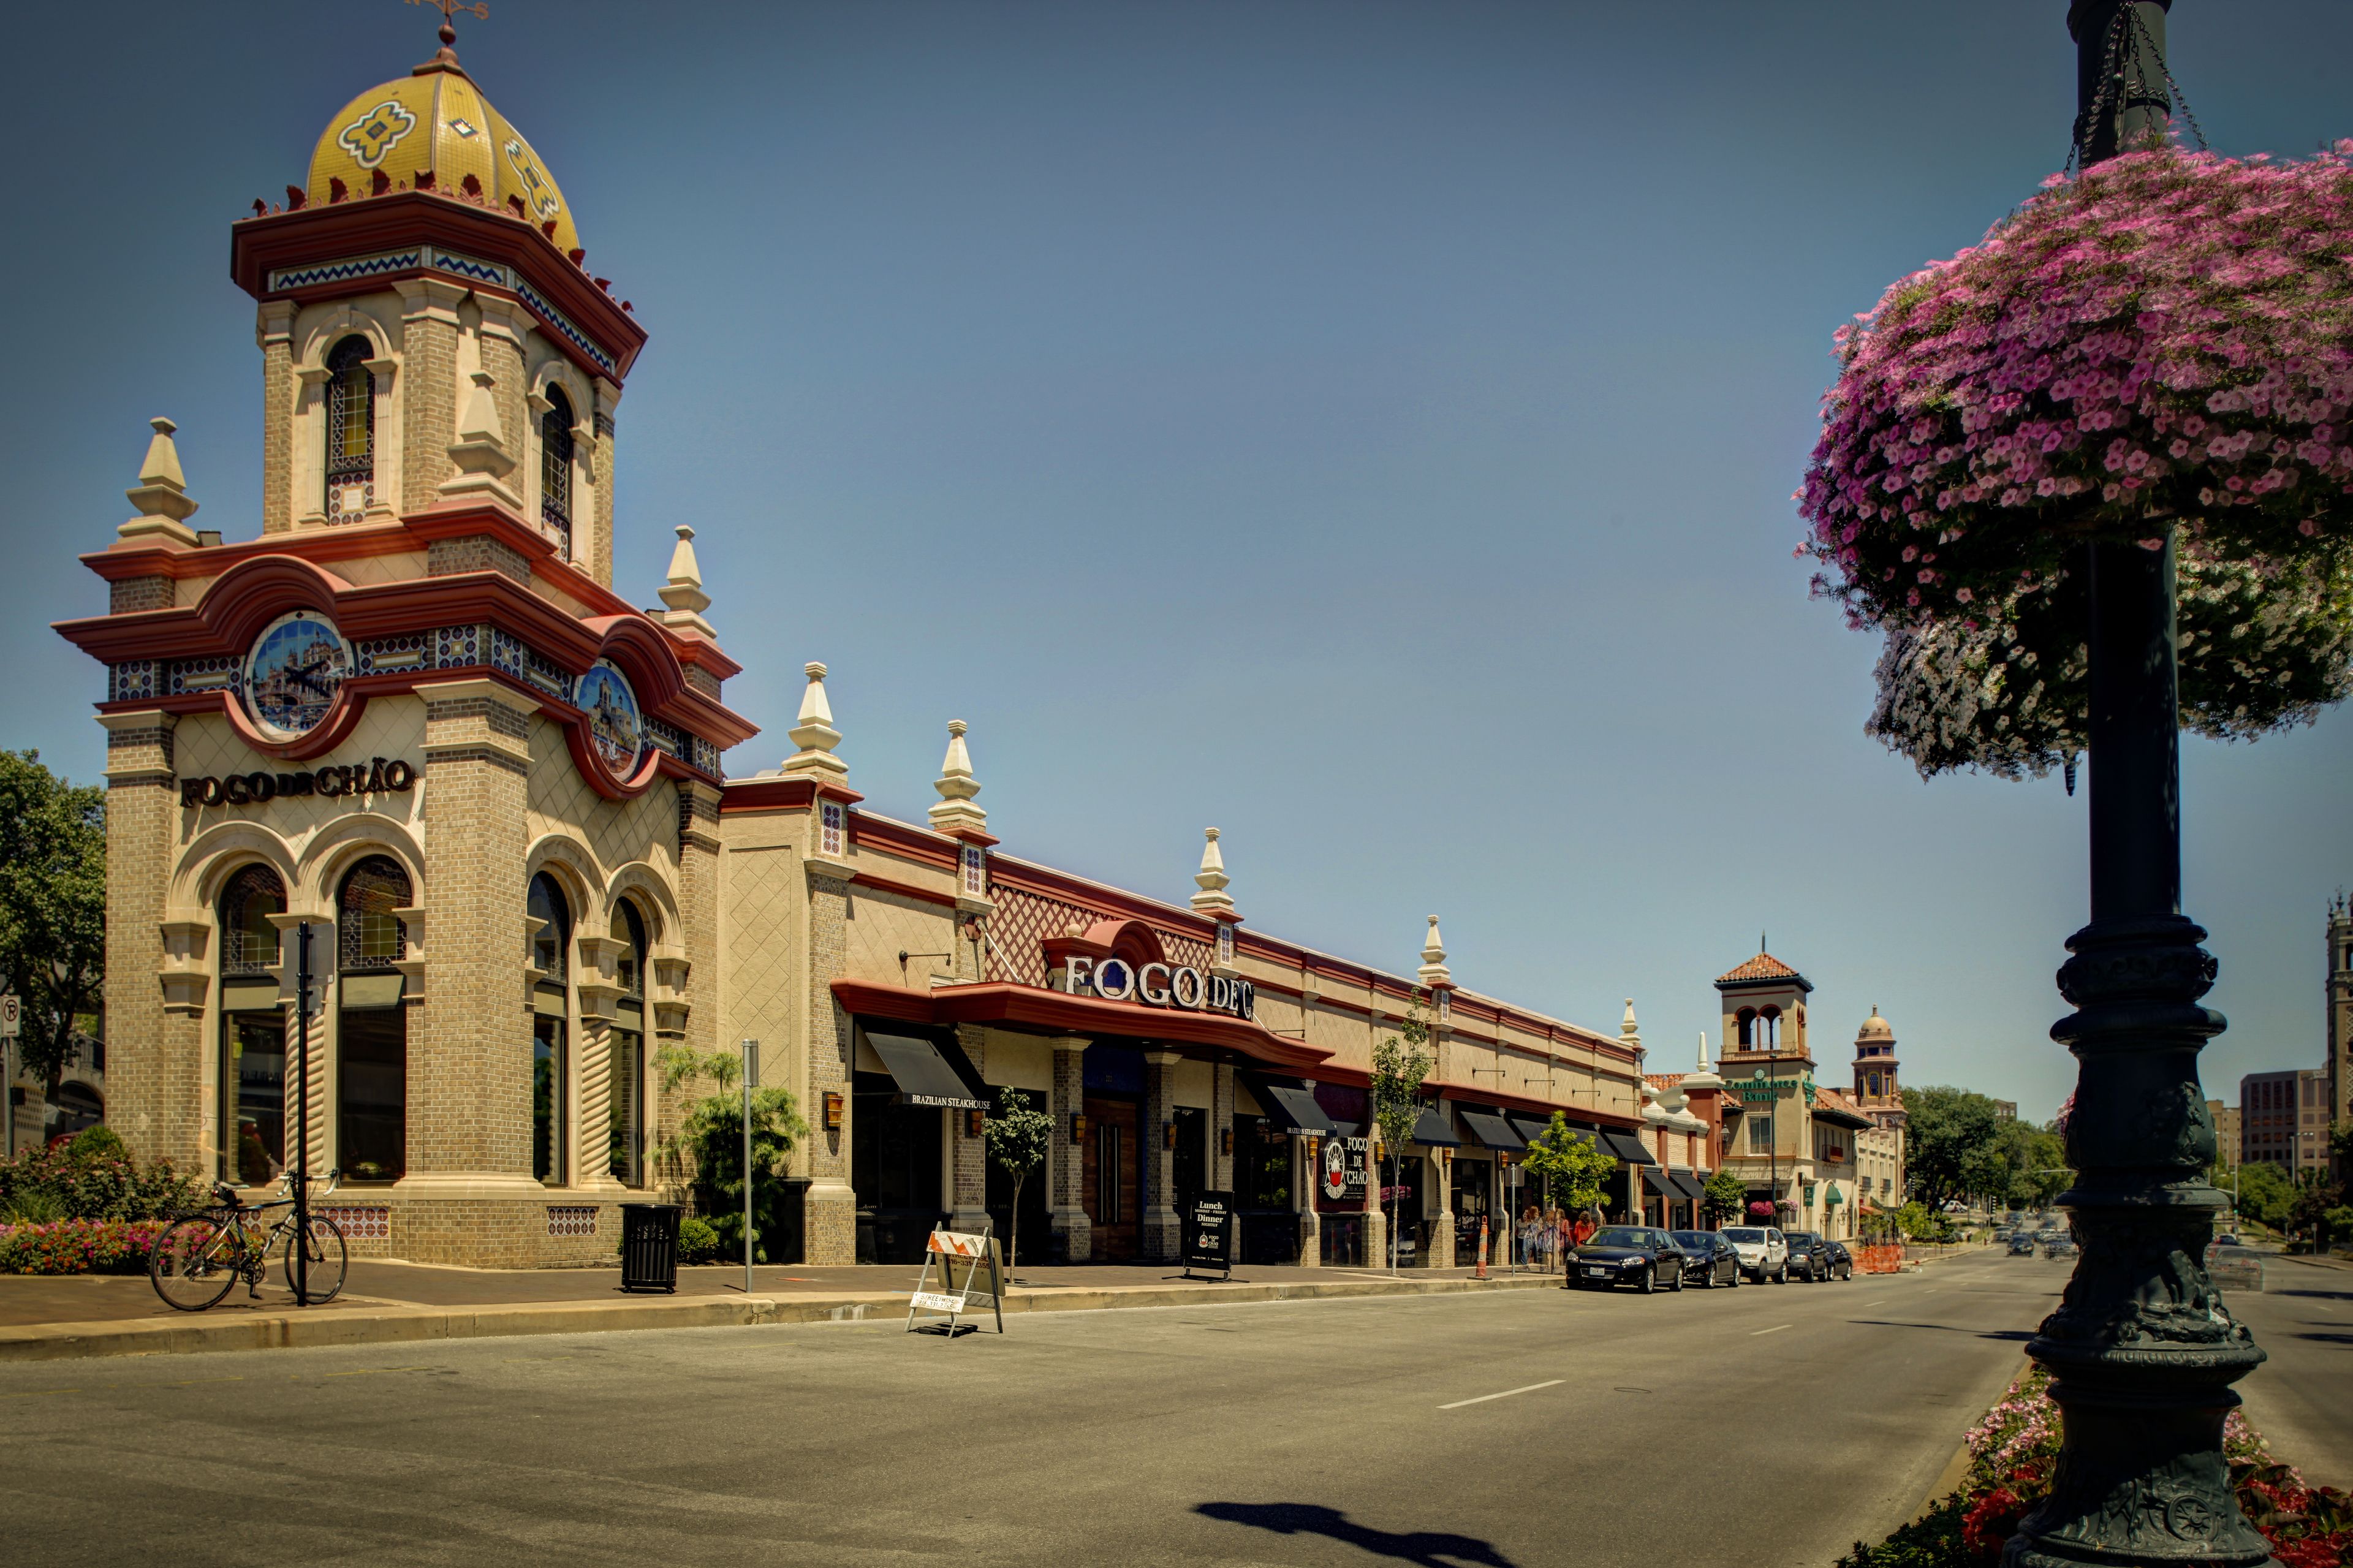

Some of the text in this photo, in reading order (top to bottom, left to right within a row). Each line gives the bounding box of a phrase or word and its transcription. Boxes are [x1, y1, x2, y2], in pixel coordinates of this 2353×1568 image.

[180, 757, 412, 808] FOGO DE CHÃO
[1064, 955, 1203, 1007] FOGO
[1207, 975, 1240, 1011] DE
[1723, 1080, 1798, 1089] Commerce
[912, 1094, 991, 1110] BRAZILIAN STEAKHOUSE
[1742, 1091, 1779, 1102] Bank
[1347, 1137, 1368, 1151] FOGO
[1354, 1155, 1362, 1167] DE
[1199, 1201, 1222, 1210] Lunch
[1197, 1214, 1224, 1223] Dinner
